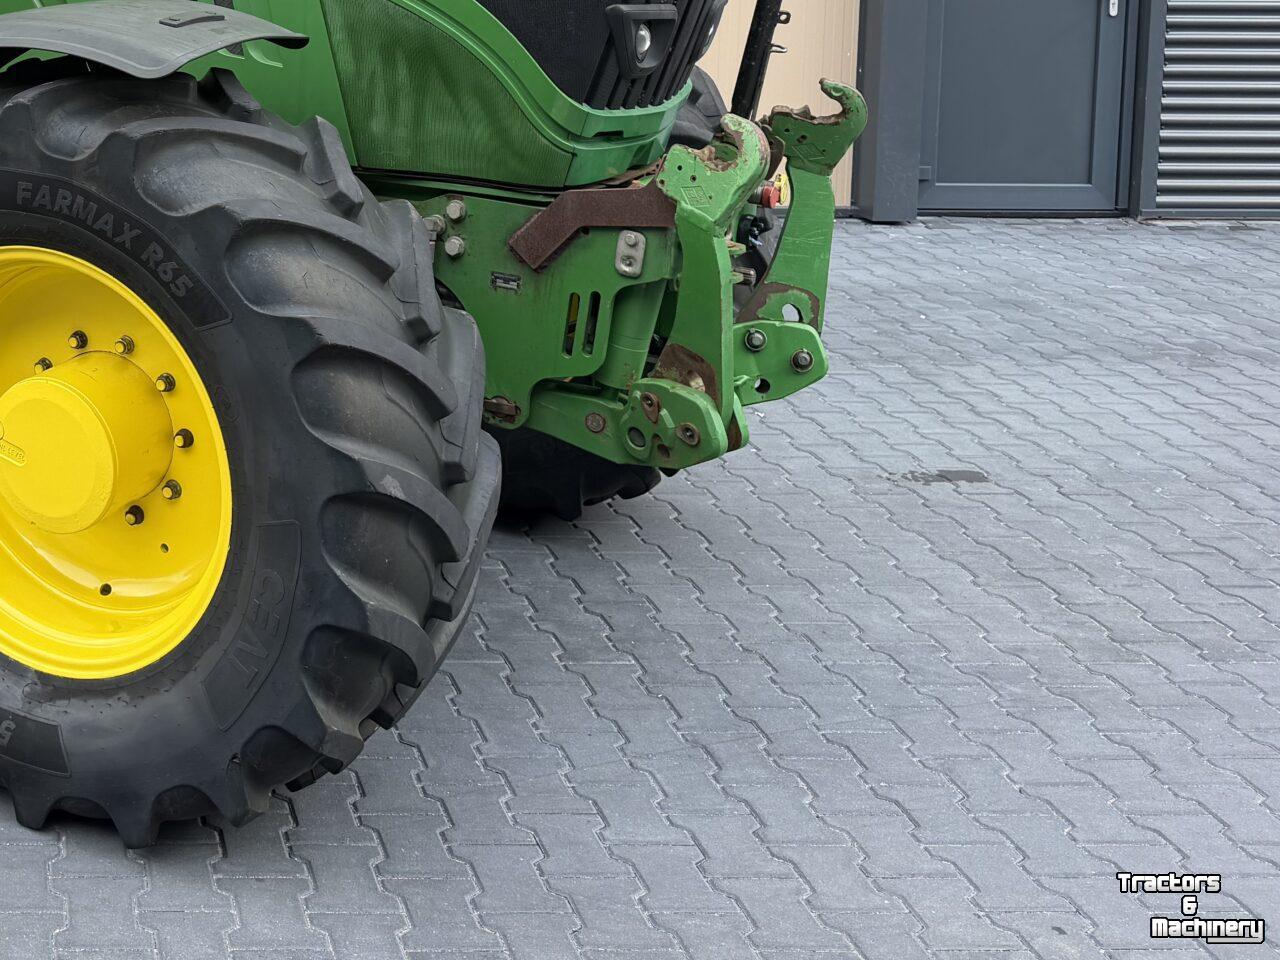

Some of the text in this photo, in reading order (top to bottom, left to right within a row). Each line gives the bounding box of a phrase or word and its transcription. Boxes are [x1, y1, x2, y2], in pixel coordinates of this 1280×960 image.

[16, 181, 194, 298] FARMAX R65
[230, 569, 285, 689] CEAT
